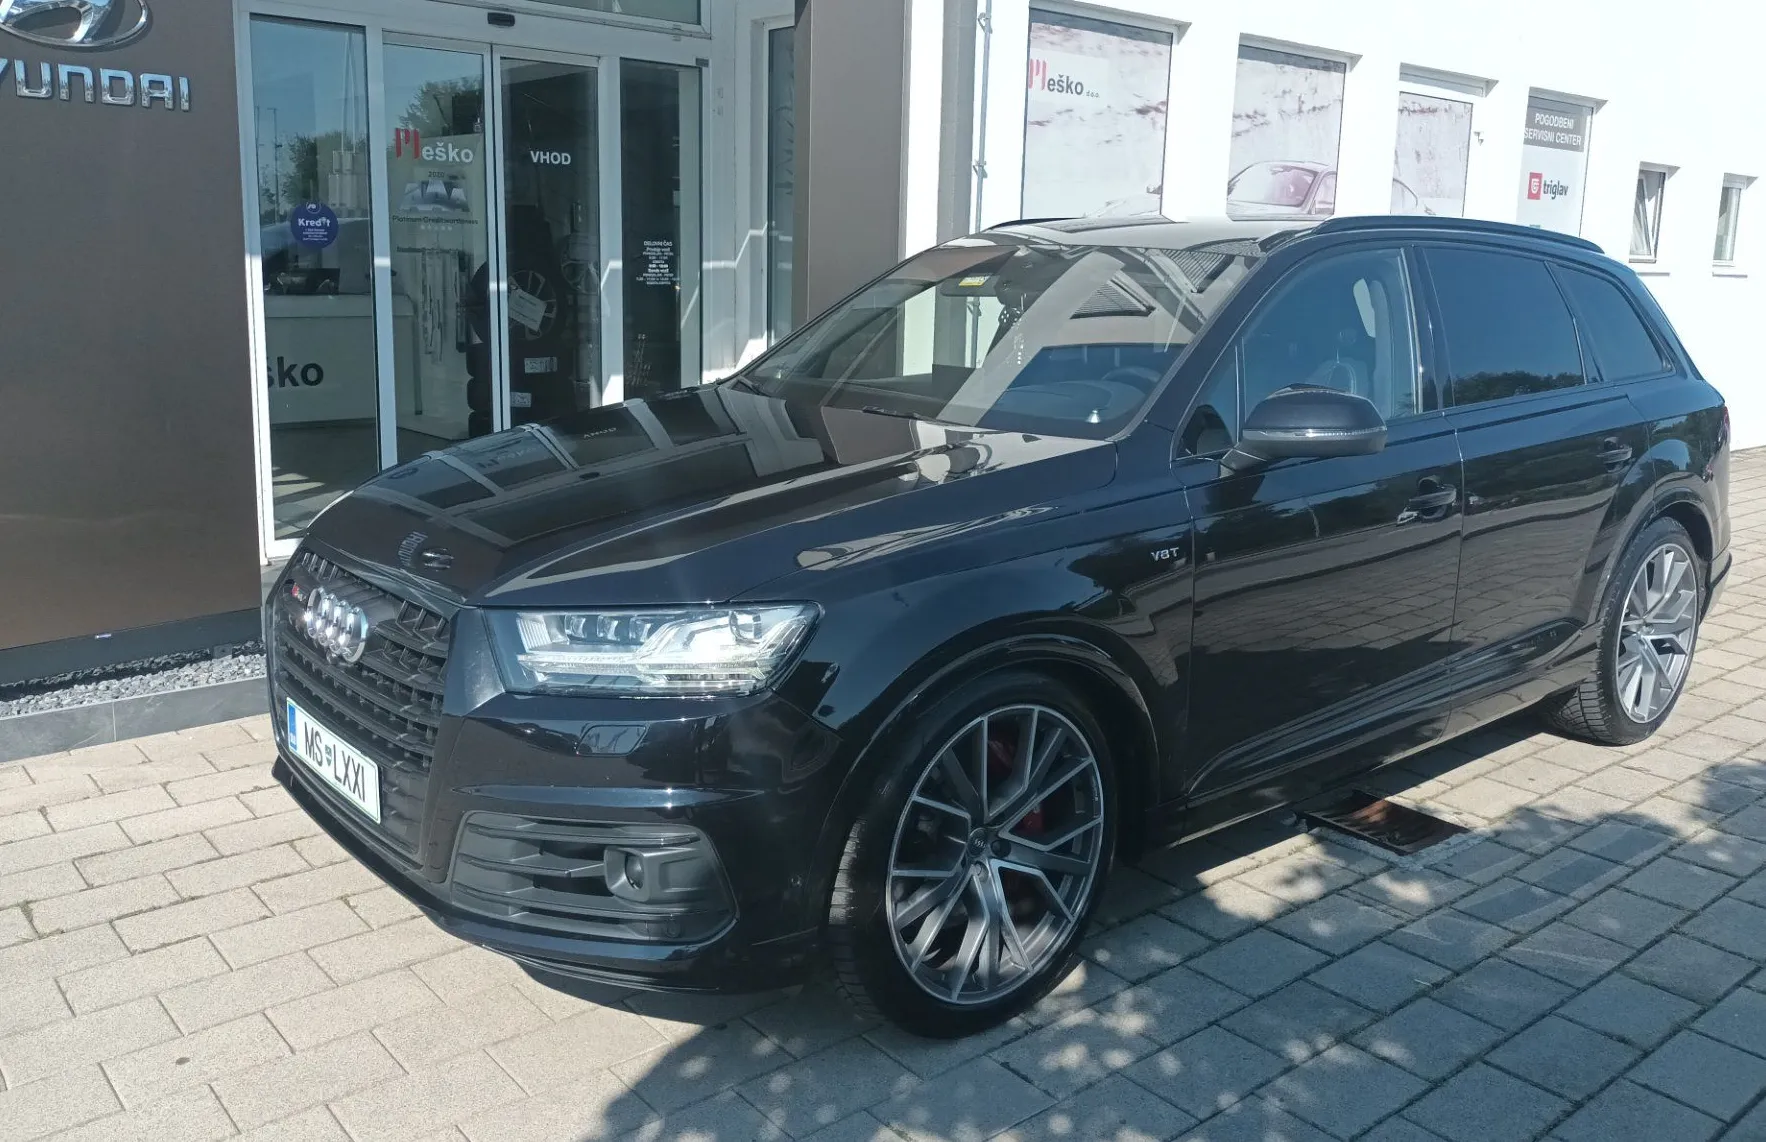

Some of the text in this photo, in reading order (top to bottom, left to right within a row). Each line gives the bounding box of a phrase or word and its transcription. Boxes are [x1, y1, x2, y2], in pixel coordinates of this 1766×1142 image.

[1534, 112, 1574, 130] POGODBENI
[1523, 127, 1581, 146] SERVISNI CENTER
[530, 150, 572, 165] VHOD
[1542, 180, 1569, 200] triglav
[1151, 547, 1179, 562] V8T
[304, 721, 365, 803] MS LXXI
